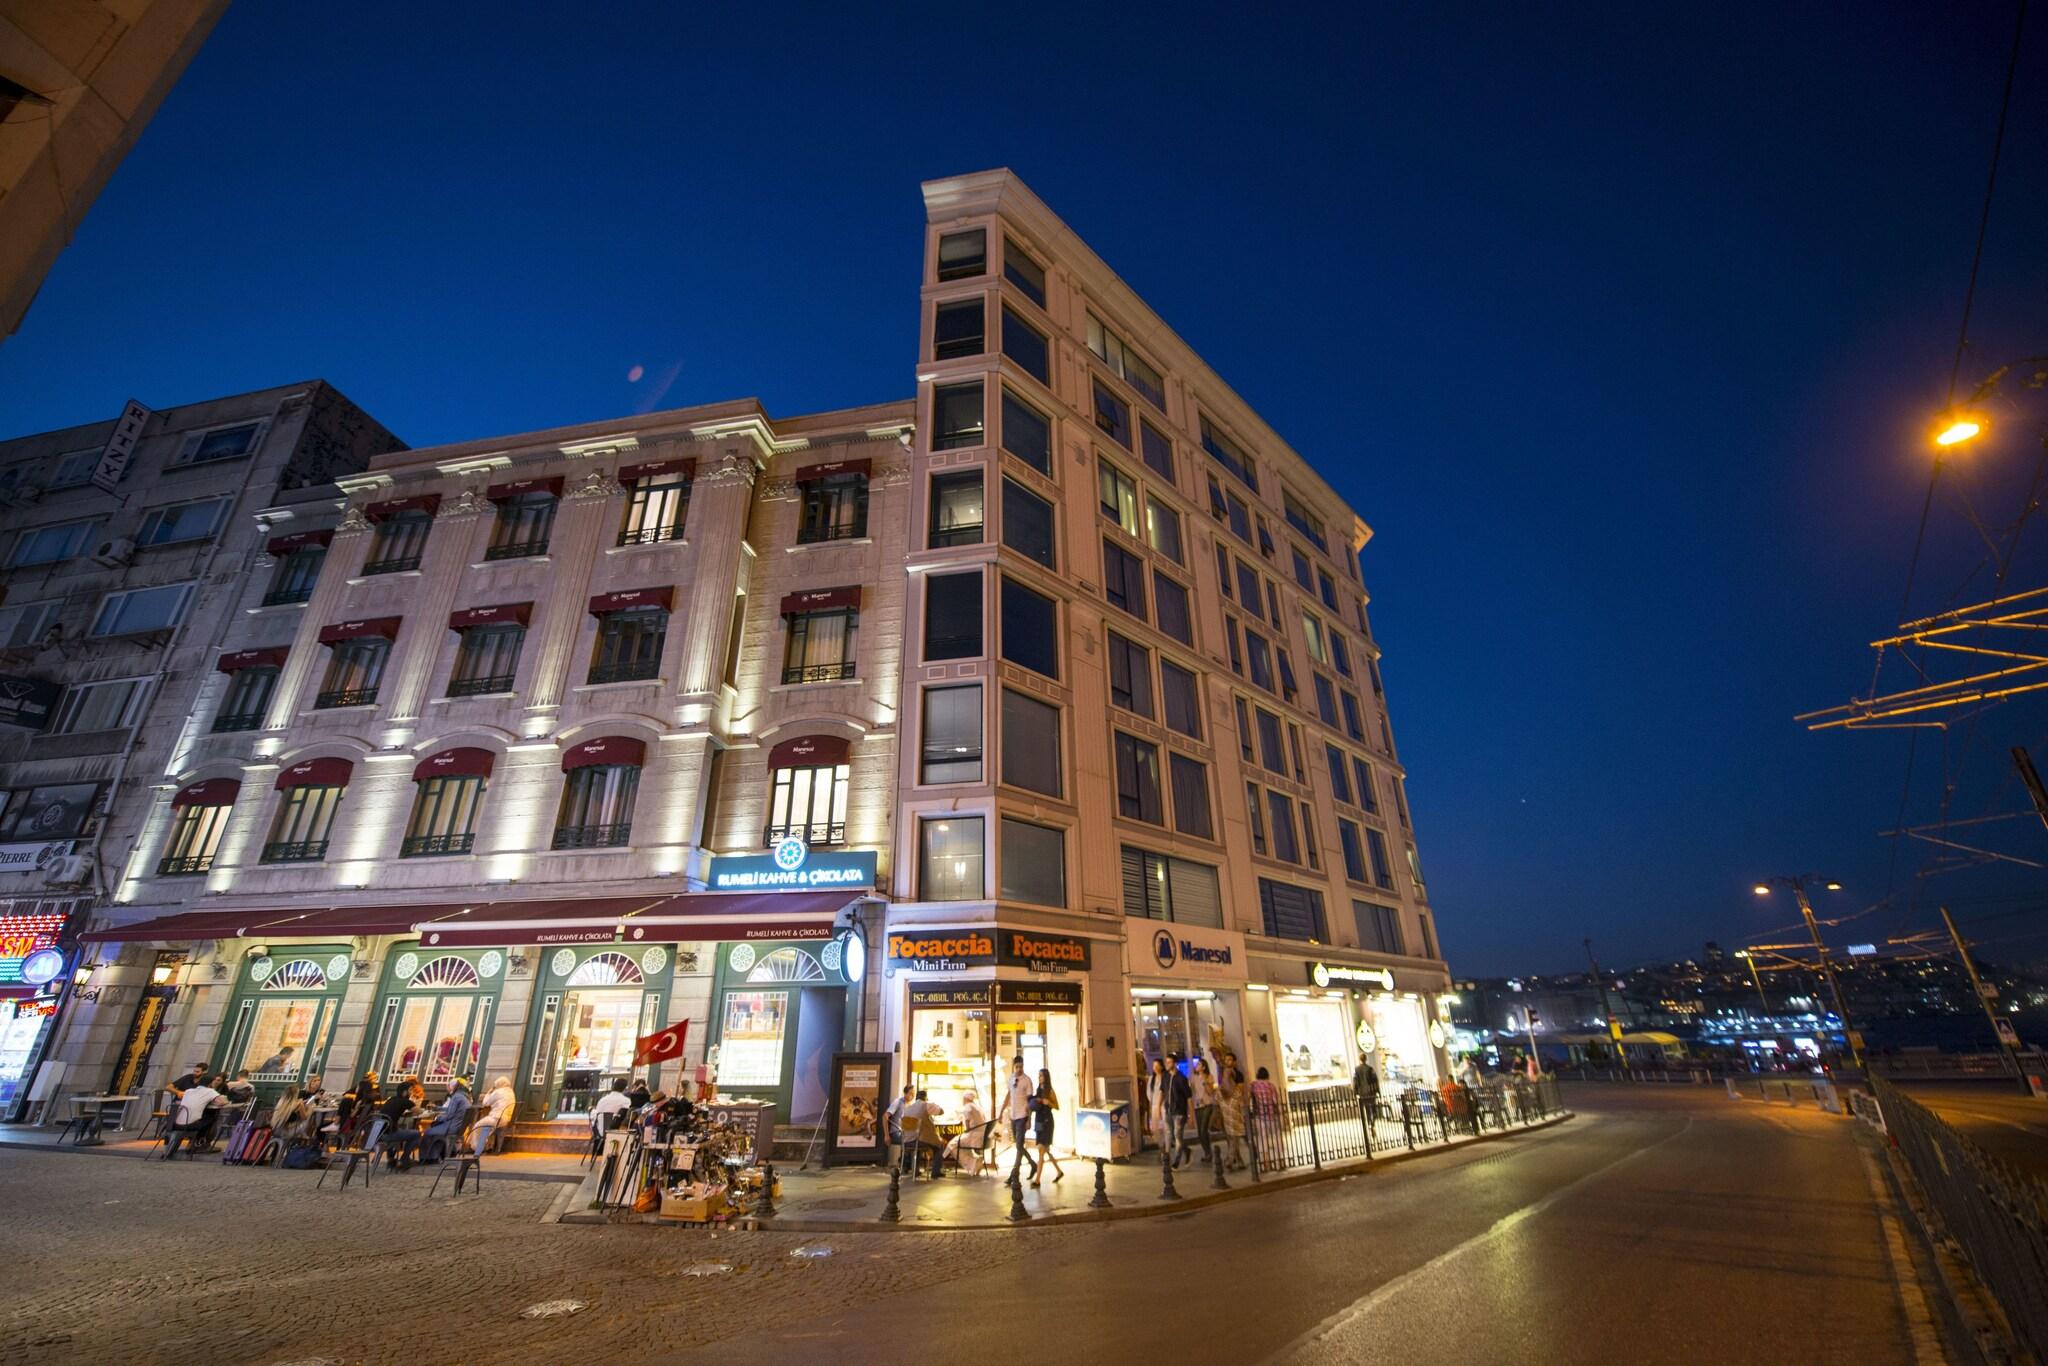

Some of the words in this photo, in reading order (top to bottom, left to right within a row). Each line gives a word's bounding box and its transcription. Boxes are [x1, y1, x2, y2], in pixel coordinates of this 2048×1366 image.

[103, 406, 144, 478] RITZY
[760, 871, 797, 885] KAHVE
[798, 871, 808, 884] &
[770, 929, 792, 937] KAHVE
[793, 929, 798, 937] &
[0, 936, 35, 958] SM
[888, 933, 992, 959] Focaccia
[1013, 935, 1084, 961] Focaccia
[1179, 939, 1232, 965] Manesol
[913, 960, 939, 971] Mini
[1031, 960, 1050, 972] Mini
